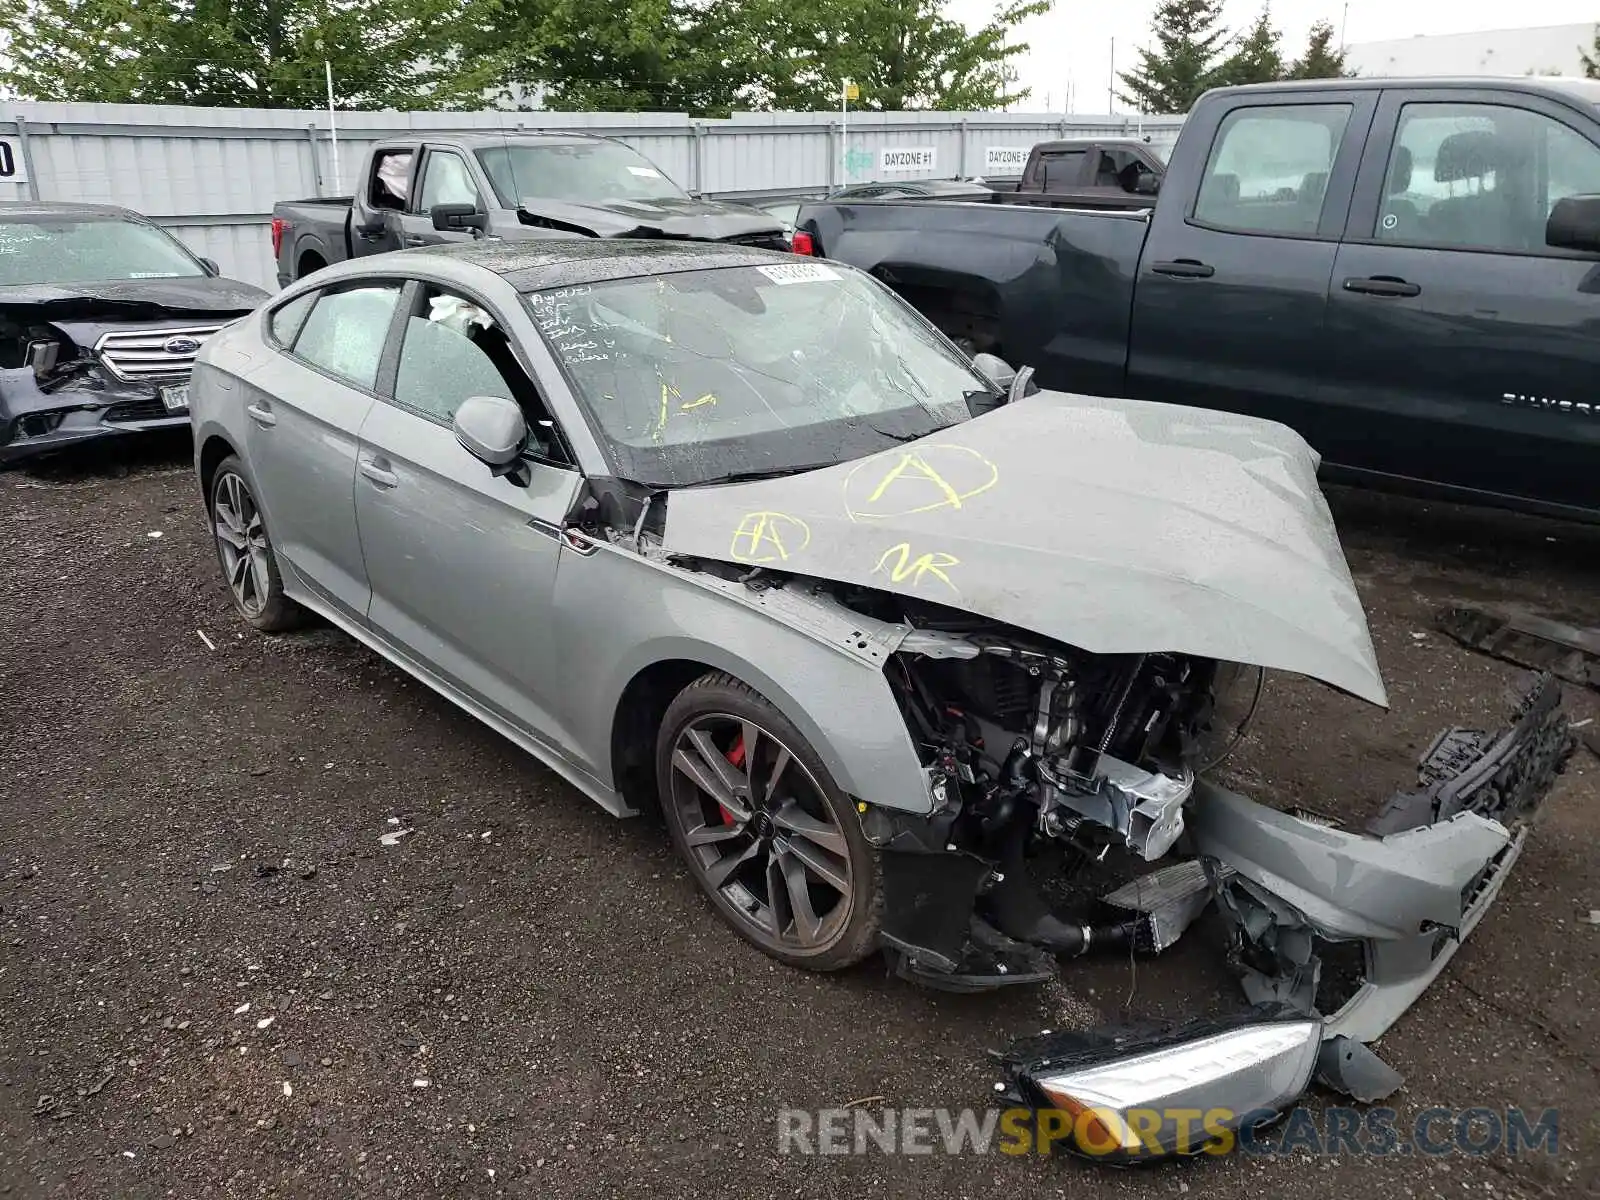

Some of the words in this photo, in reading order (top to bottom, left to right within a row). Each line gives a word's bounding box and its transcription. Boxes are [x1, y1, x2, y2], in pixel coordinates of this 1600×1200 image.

[885, 151, 921, 166] DAYZONE
[923, 151, 932, 165] #1
[989, 151, 1021, 162] DAYZONE
